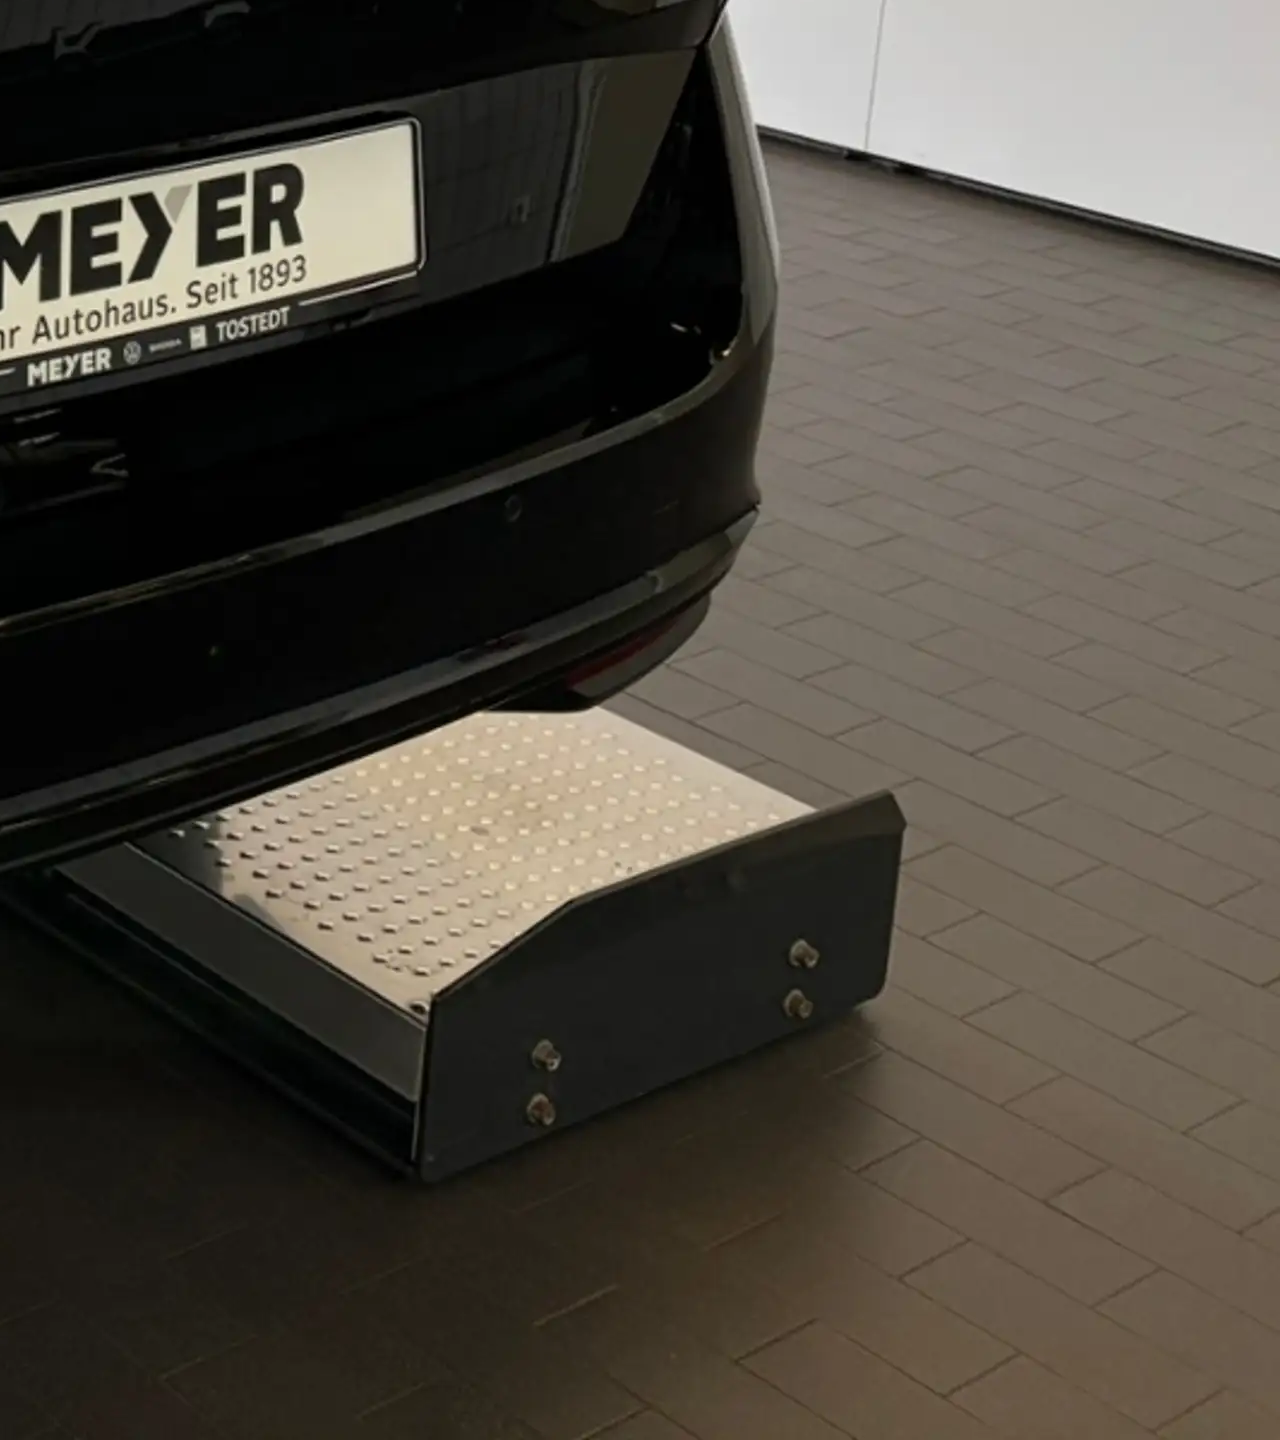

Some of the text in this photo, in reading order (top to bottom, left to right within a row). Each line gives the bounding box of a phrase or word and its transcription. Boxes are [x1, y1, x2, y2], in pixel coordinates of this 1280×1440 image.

[31, 295, 178, 345] Autohaus.
[186, 271, 239, 309] Seit
[247, 254, 307, 294] 1893
[27, 347, 112, 387] MEYER
[216, 306, 291, 343] TOSTEDT
